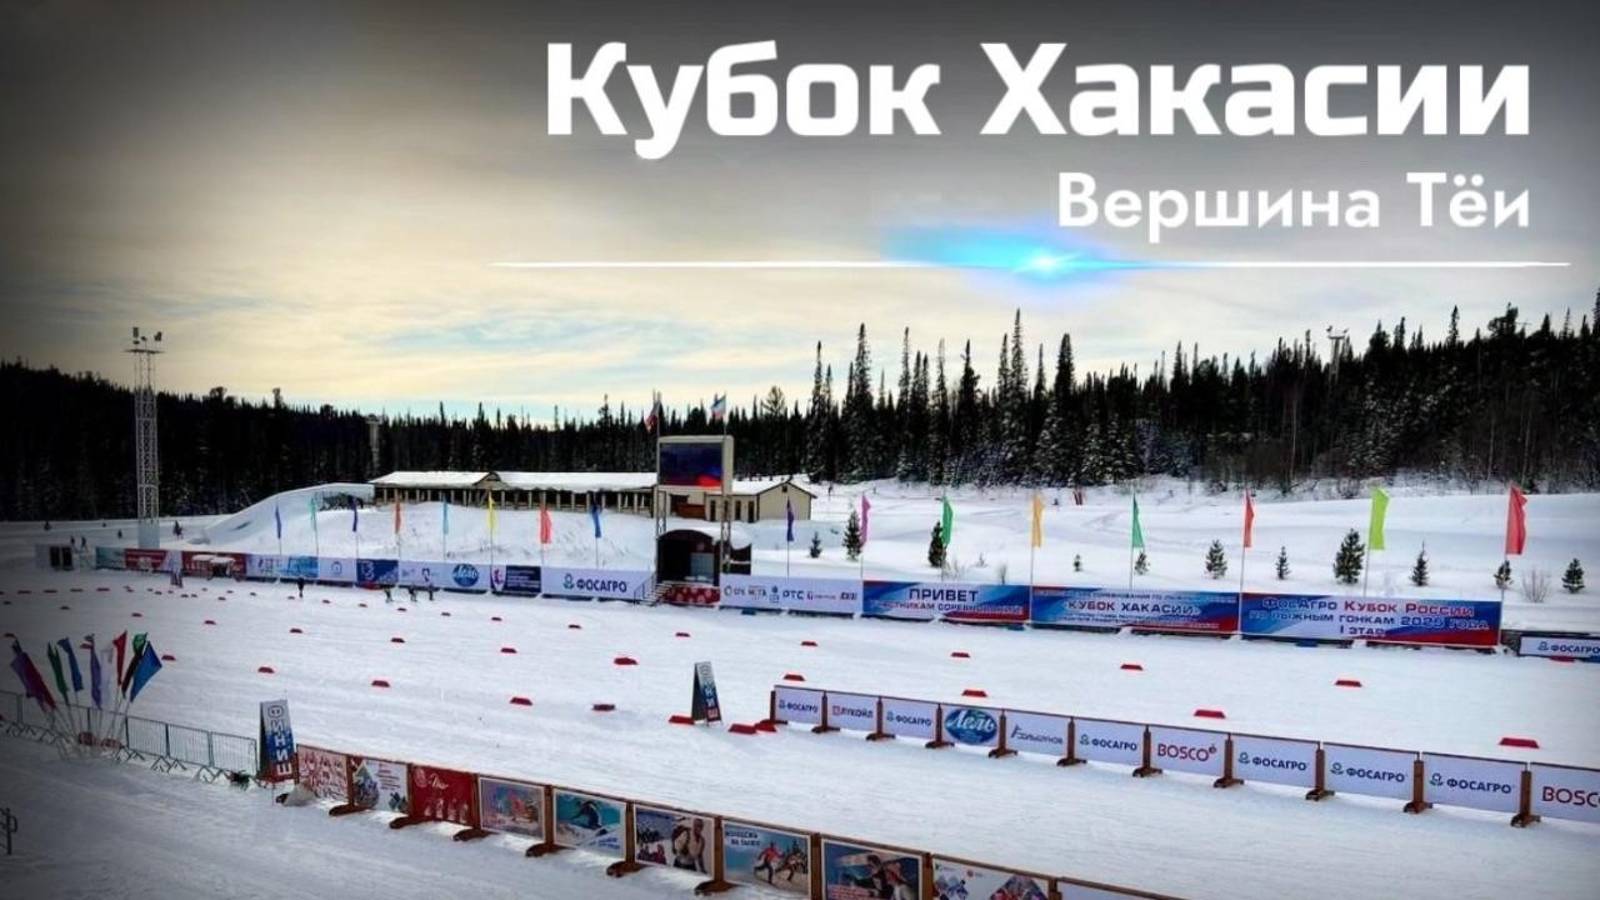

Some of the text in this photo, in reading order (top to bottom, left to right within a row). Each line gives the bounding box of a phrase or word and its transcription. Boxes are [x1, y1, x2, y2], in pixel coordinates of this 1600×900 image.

[576, 578, 627, 593] ФОСАГРО
[909, 588, 978, 602] ПРИВЕТ
[1339, 614, 1395, 625] ГОНКАМ
[896, 714, 932, 727] ФОСАГРО
[1092, 738, 1138, 752] ФОСАГРО
[1158, 743, 1210, 762] BOSCO
[1252, 756, 1308, 772] ФОСАГРО
[1346, 768, 1405, 783] ФОСАГРО
[1447, 778, 1513, 795] ФОСАГРО
[1542, 785, 1600, 808] BOSC
